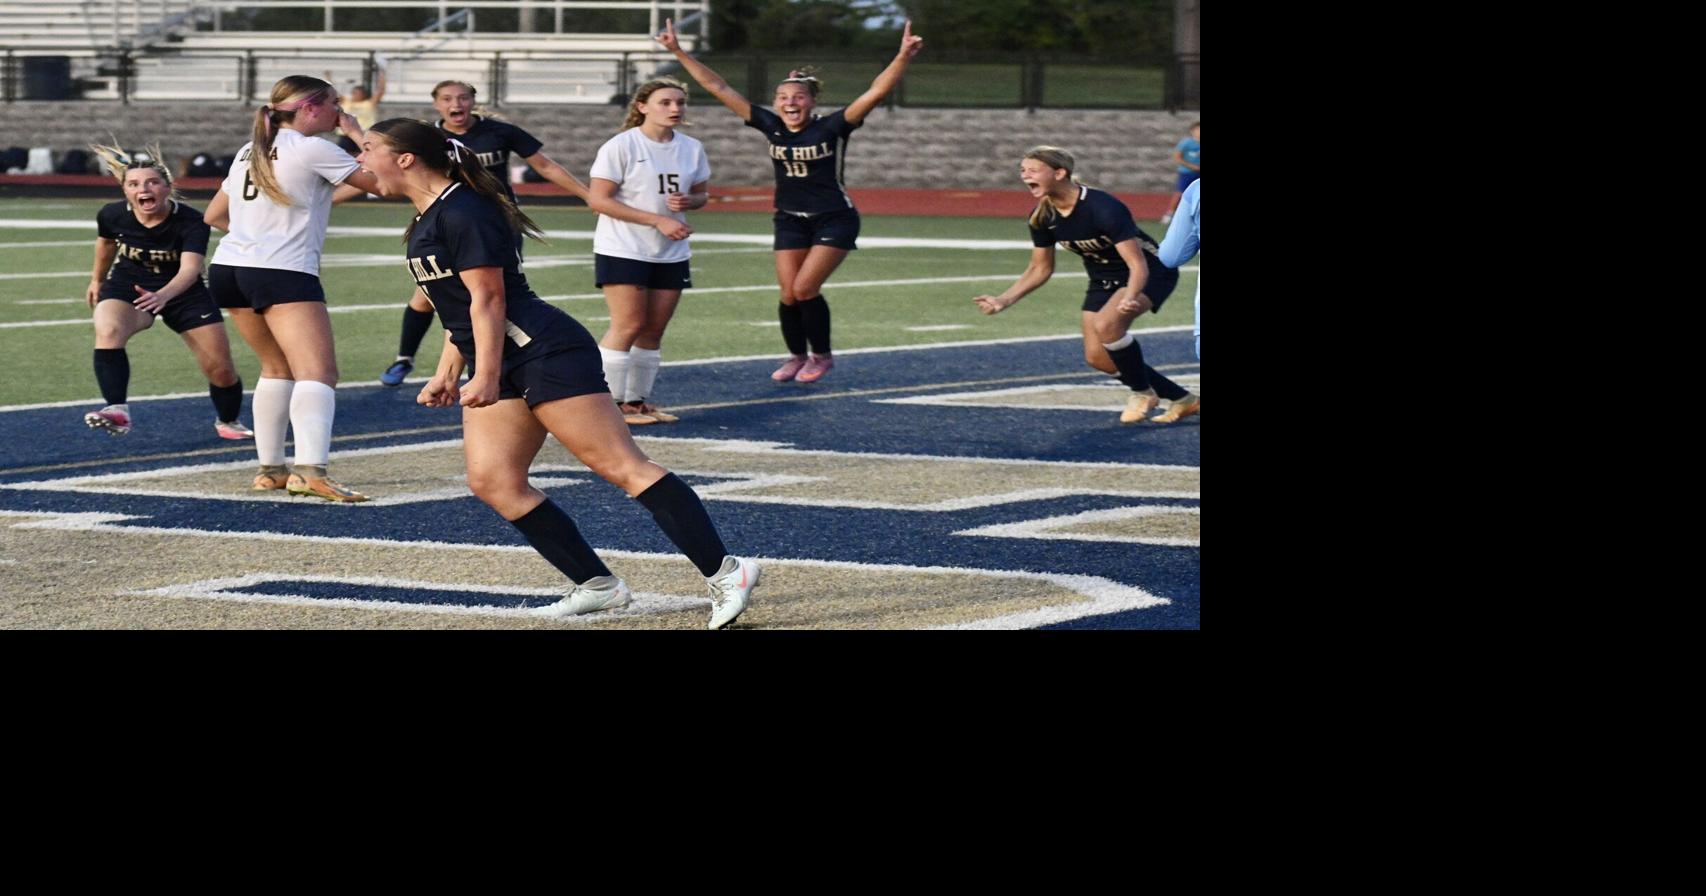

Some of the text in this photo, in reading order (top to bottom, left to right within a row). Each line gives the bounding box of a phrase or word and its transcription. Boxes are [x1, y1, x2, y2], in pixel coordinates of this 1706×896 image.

[791, 142, 833, 160] HILL
[783, 161, 808, 177] 10
[658, 174, 679, 194] 15
